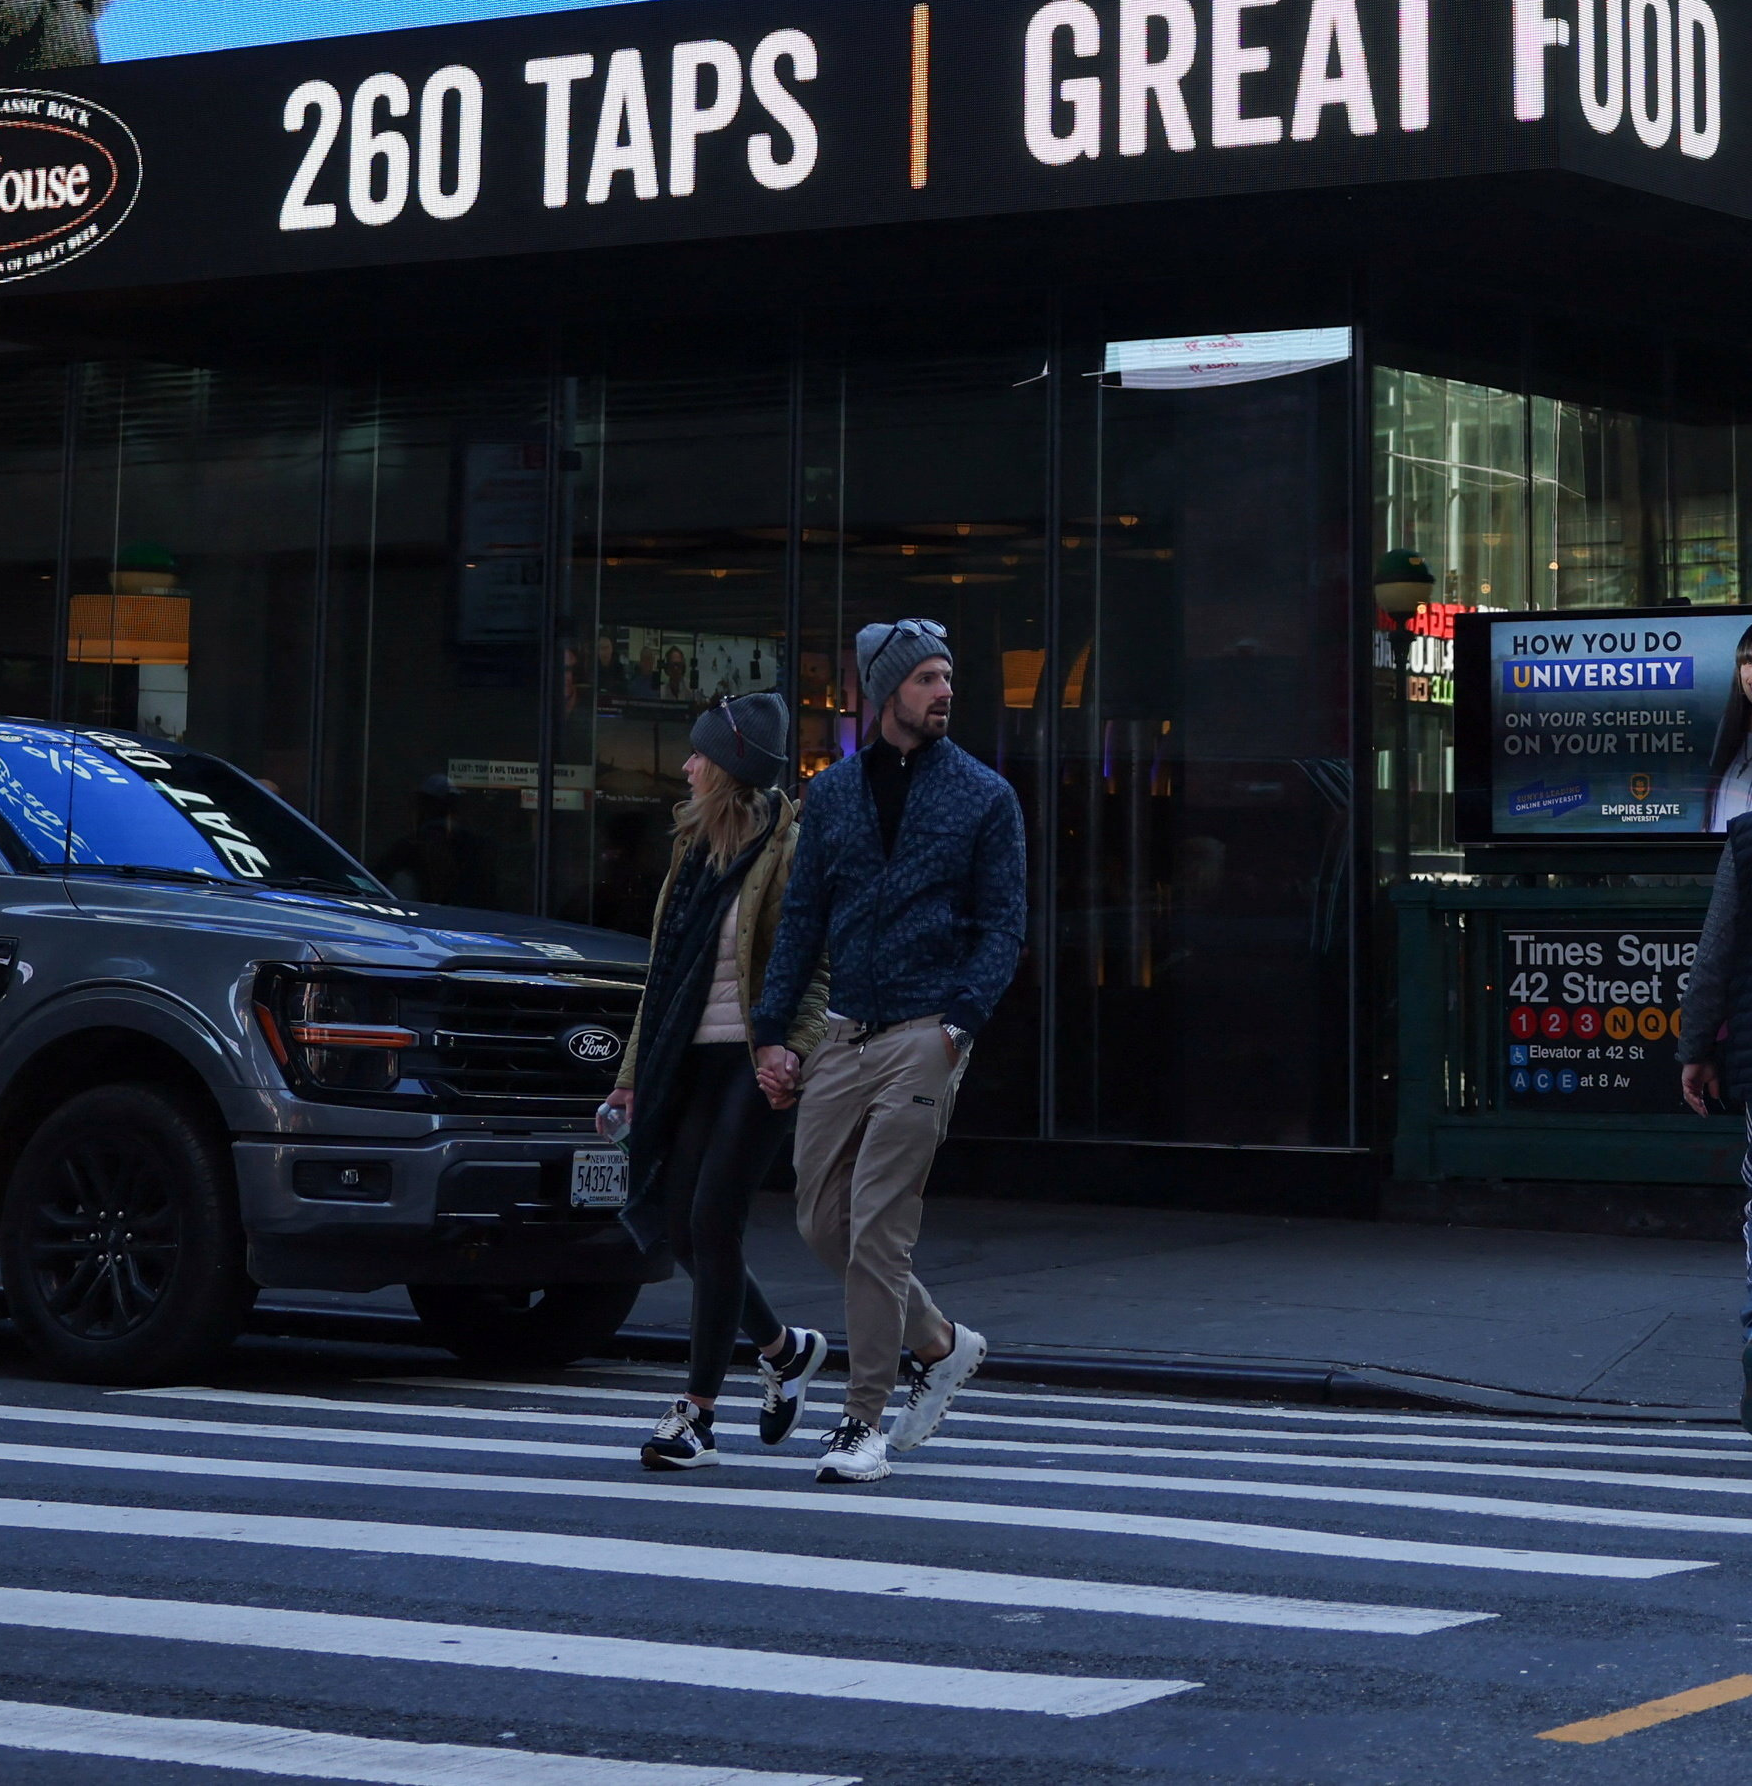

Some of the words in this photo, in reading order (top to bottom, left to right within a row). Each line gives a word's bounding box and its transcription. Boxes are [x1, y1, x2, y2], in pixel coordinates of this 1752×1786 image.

[46, 100, 93, 129] ROCK
[279, 65, 484, 233] 260
[524, 28, 820, 209] TAPS
[1512, 633, 1575, 656] HOW
[1582, 632, 1637, 654] YOU
[1644, 630, 1682, 652] DO
[1513, 661, 1683, 688] UNIVERSITY
[1505, 713, 1532, 728] ON
[1538, 711, 1587, 727] YOUR
[1592, 710, 1693, 727] SCHEDULE.
[1504, 734, 1541, 756] ON
[1551, 733, 1618, 755] YOUR
[1625, 732, 1694, 754] TIME.
[1545, 785, 1581, 799] LEADING
[1515, 801, 1542, 812] ONLINE
[1542, 793, 1583, 807] UNIVERSITY
[1601, 804, 1643, 816] EMPIRE
[1645, 803, 1680, 815] STATE
[1620, 815, 1660, 823] UNIVERSITY
[1508, 934, 1604, 967] Times
[1616, 933, 1699, 973] Squa
[1508, 971, 1550, 1003] 42
[1561, 971, 1663, 1005] Street
[1517, 1013, 1527, 1032] 1
[1548, 1013, 1561, 1032] 2
[1580, 1013, 1594, 1033] 3
[1612, 1014, 1627, 1032] N
[1643, 1014, 1660, 1033] Q
[578, 1033, 612, 1057] Ford
[1529, 1044, 1582, 1060] Elevator
[1587, 1046, 1601, 1060] at
[1605, 1045, 1625, 1060] 42
[1628, 1045, 1645, 1060] St
[1514, 1072, 1527, 1088] A
[1536, 1072, 1549, 1088] C
[1561, 1073, 1572, 1088] E
[1580, 1074, 1594, 1088] at
[1598, 1074, 1609, 1088] 8
[1613, 1074, 1631, 1088] Av
[590, 1154, 607, 1164] NEW
[607, 1154, 625, 1164] YORK
[588, 1195, 621, 1203] COMMERCIAL
